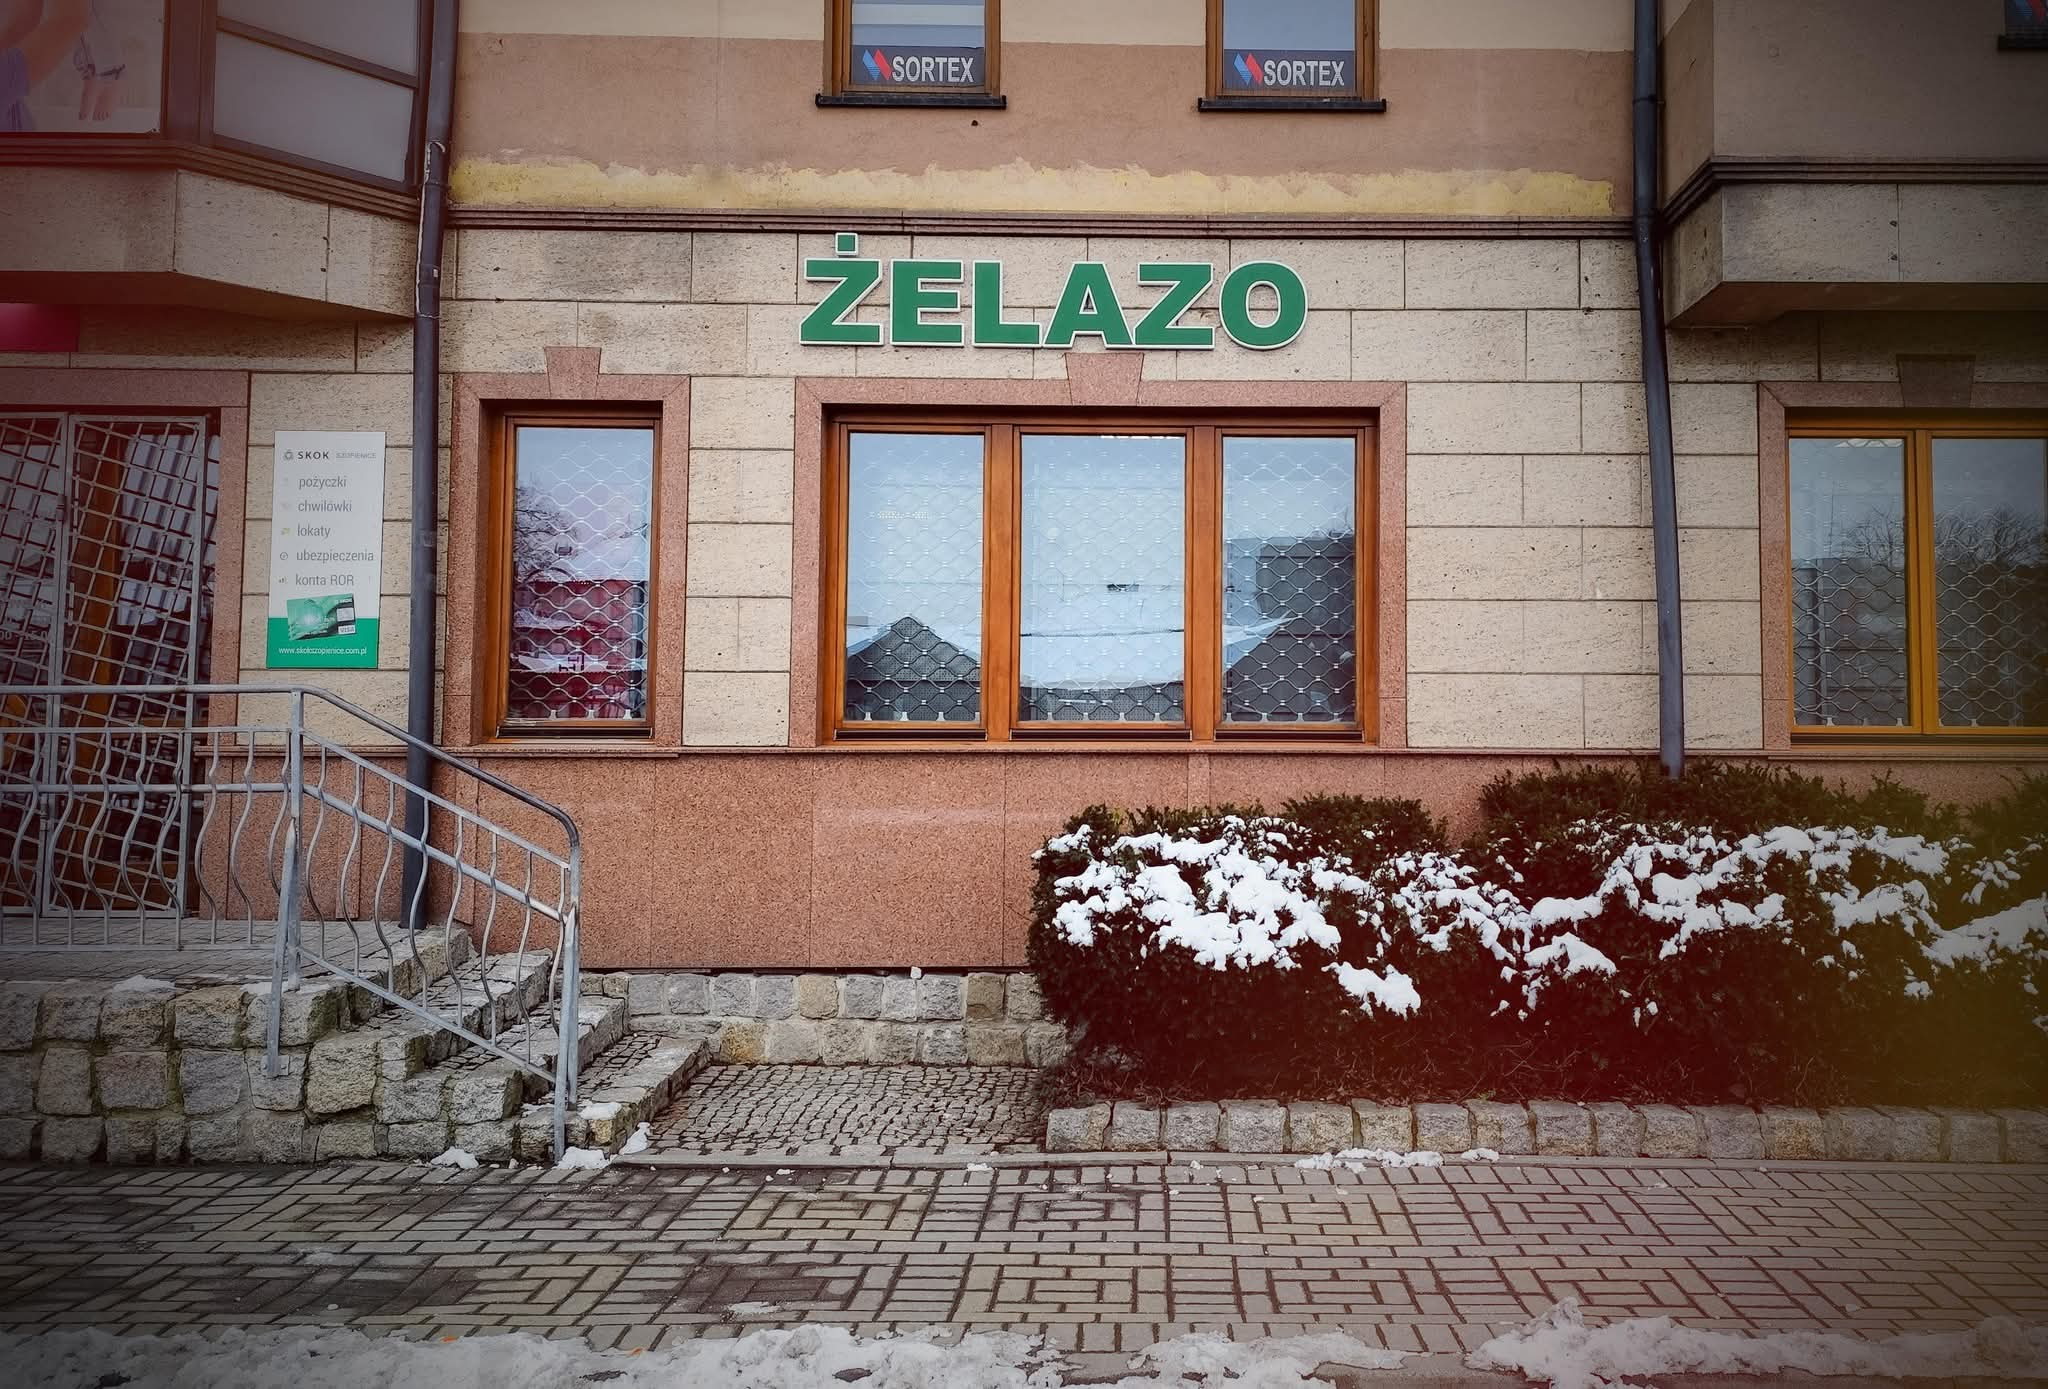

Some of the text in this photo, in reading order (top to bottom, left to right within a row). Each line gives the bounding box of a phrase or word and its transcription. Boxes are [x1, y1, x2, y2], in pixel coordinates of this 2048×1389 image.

[892, 55, 974, 82] SORTEX
[1263, 60, 1345, 86] SORTEX
[800, 232, 1308, 350] ŻELAZO
[297, 450, 330, 460] SKOK
[298, 475, 347, 491] pożyczki
[297, 499, 353, 513] chwilówki
[297, 523, 332, 539] lokaty
[296, 548, 374, 564] ubezpieczenia
[295, 573, 355, 586] konta ROR
